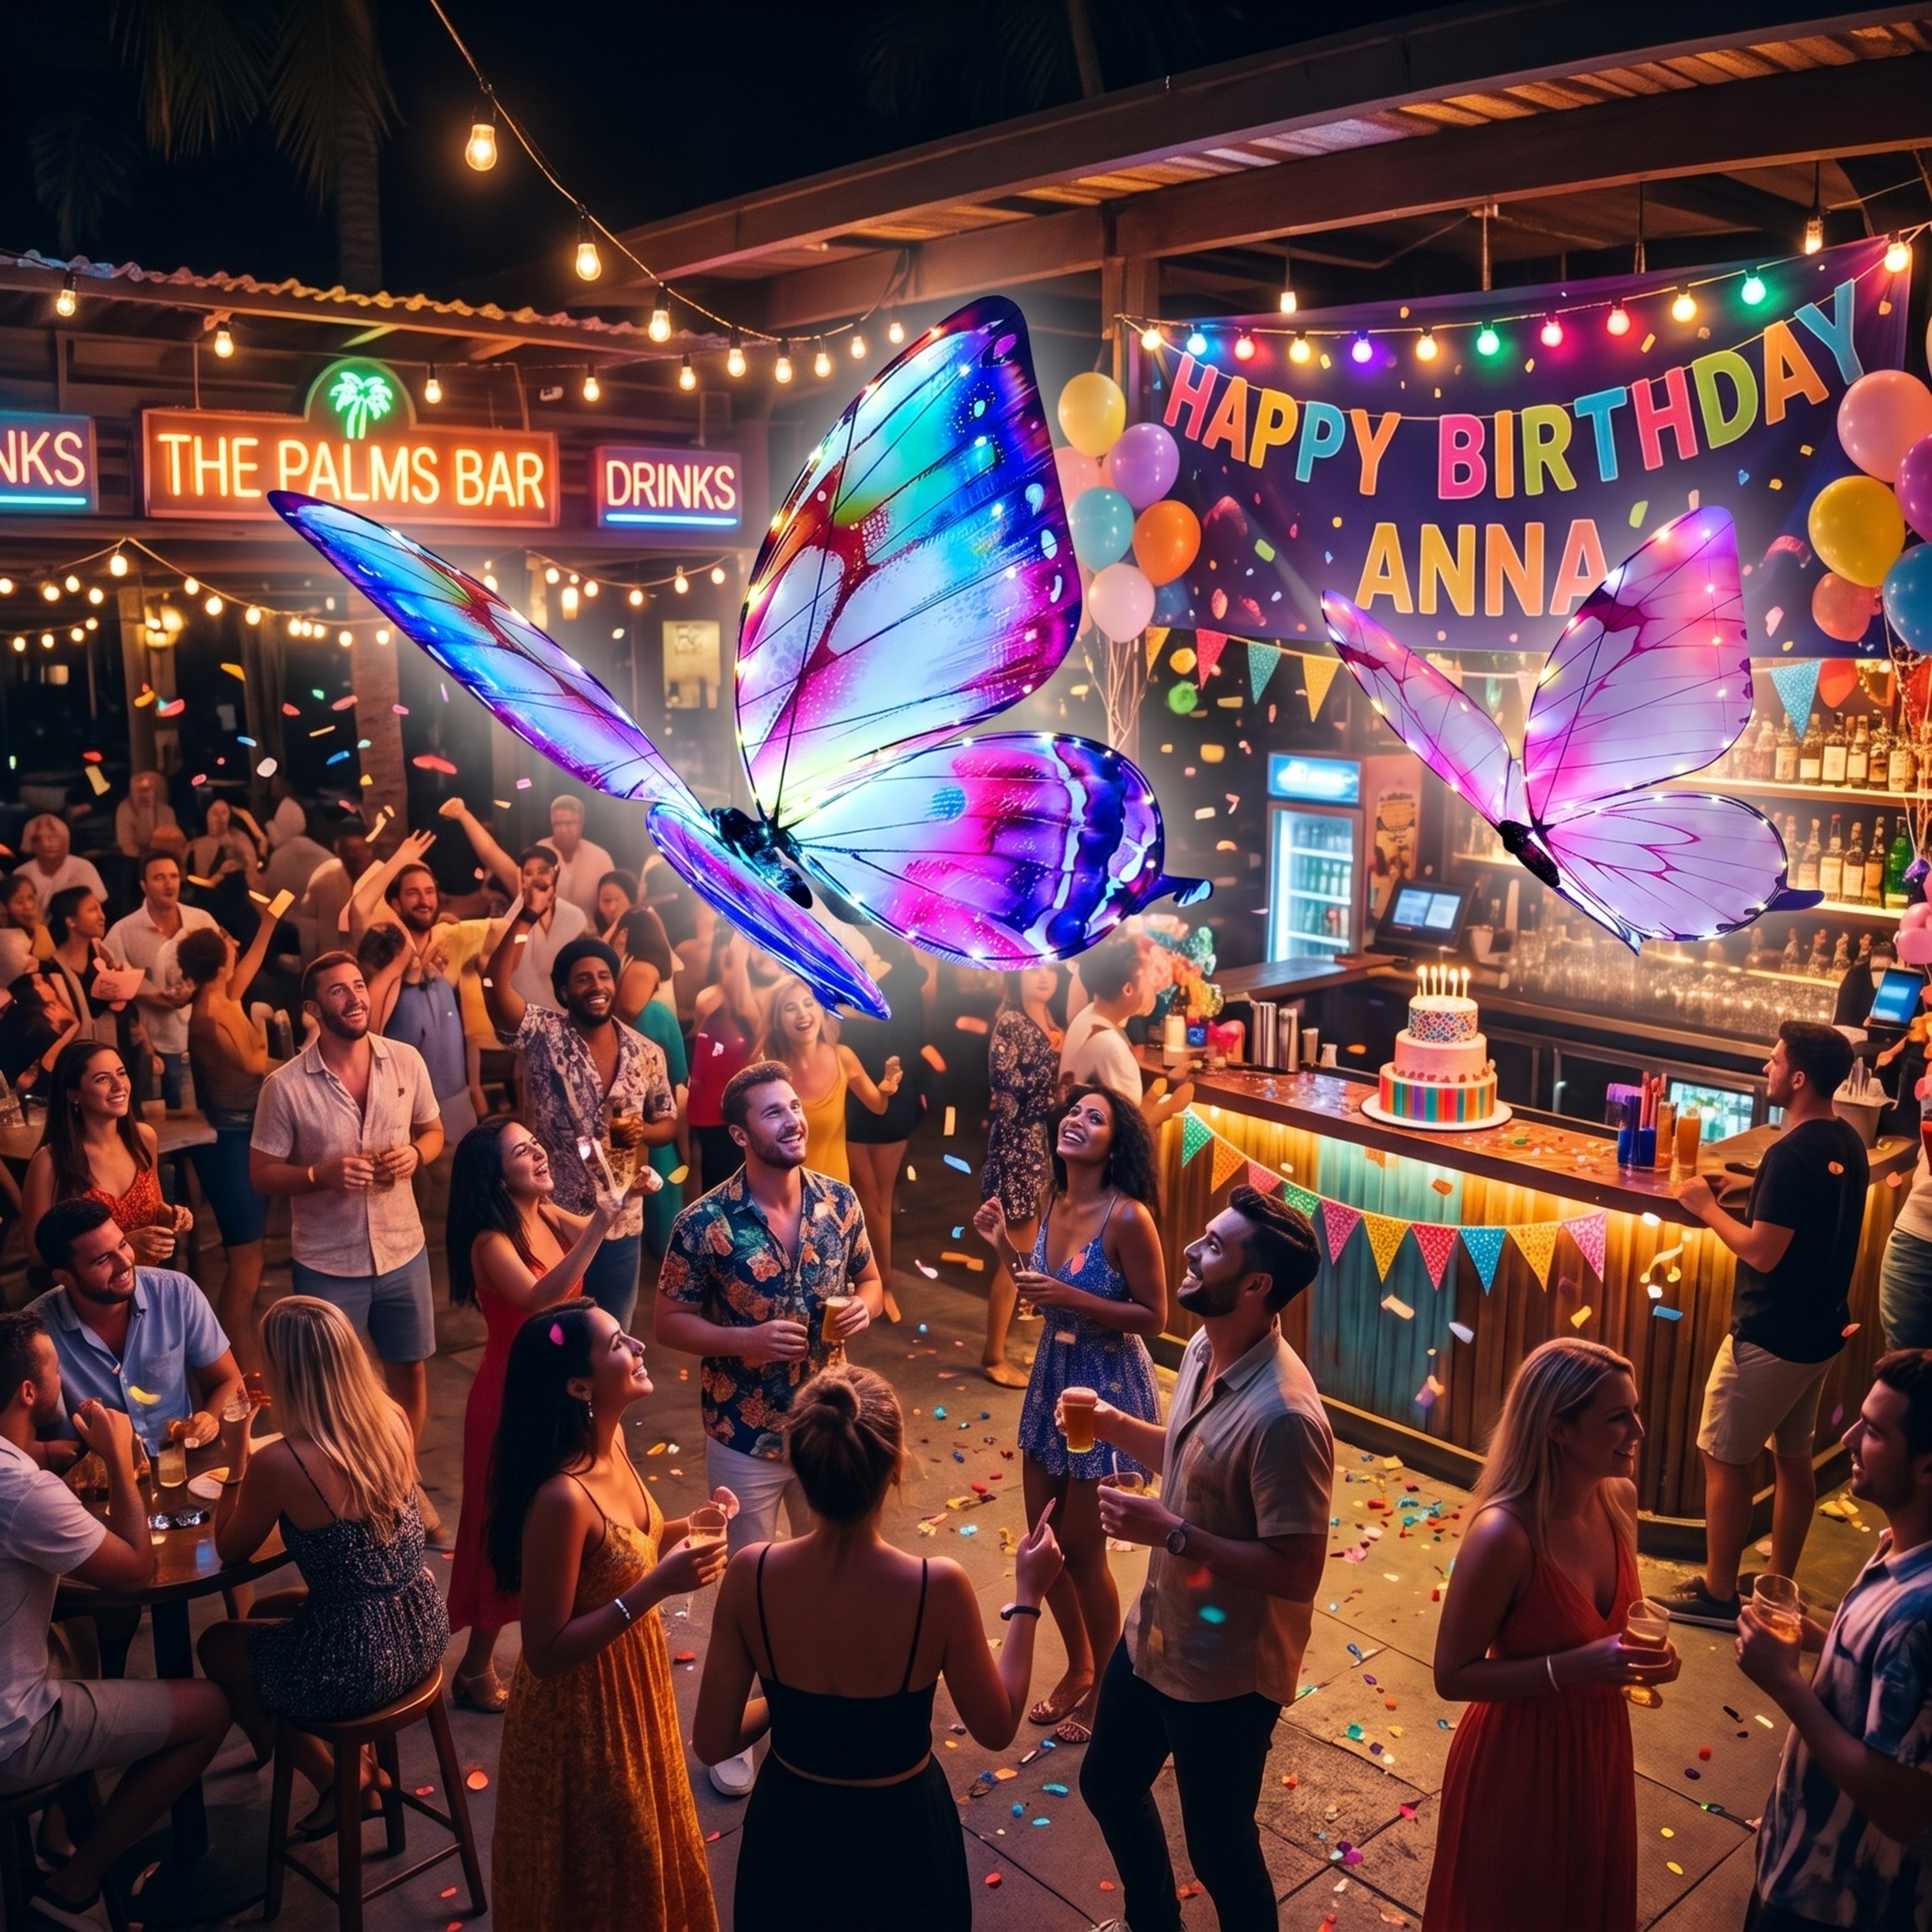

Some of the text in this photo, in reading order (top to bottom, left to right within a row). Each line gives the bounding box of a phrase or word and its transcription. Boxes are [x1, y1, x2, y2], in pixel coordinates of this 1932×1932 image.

[1163, 278, 1865, 500] HAPPY BIRTHDAY
[158, 433, 545, 509] THE PALMS BAR
[607, 460, 736, 510] DRINKS
[1354, 519, 1609, 616] ANNA
